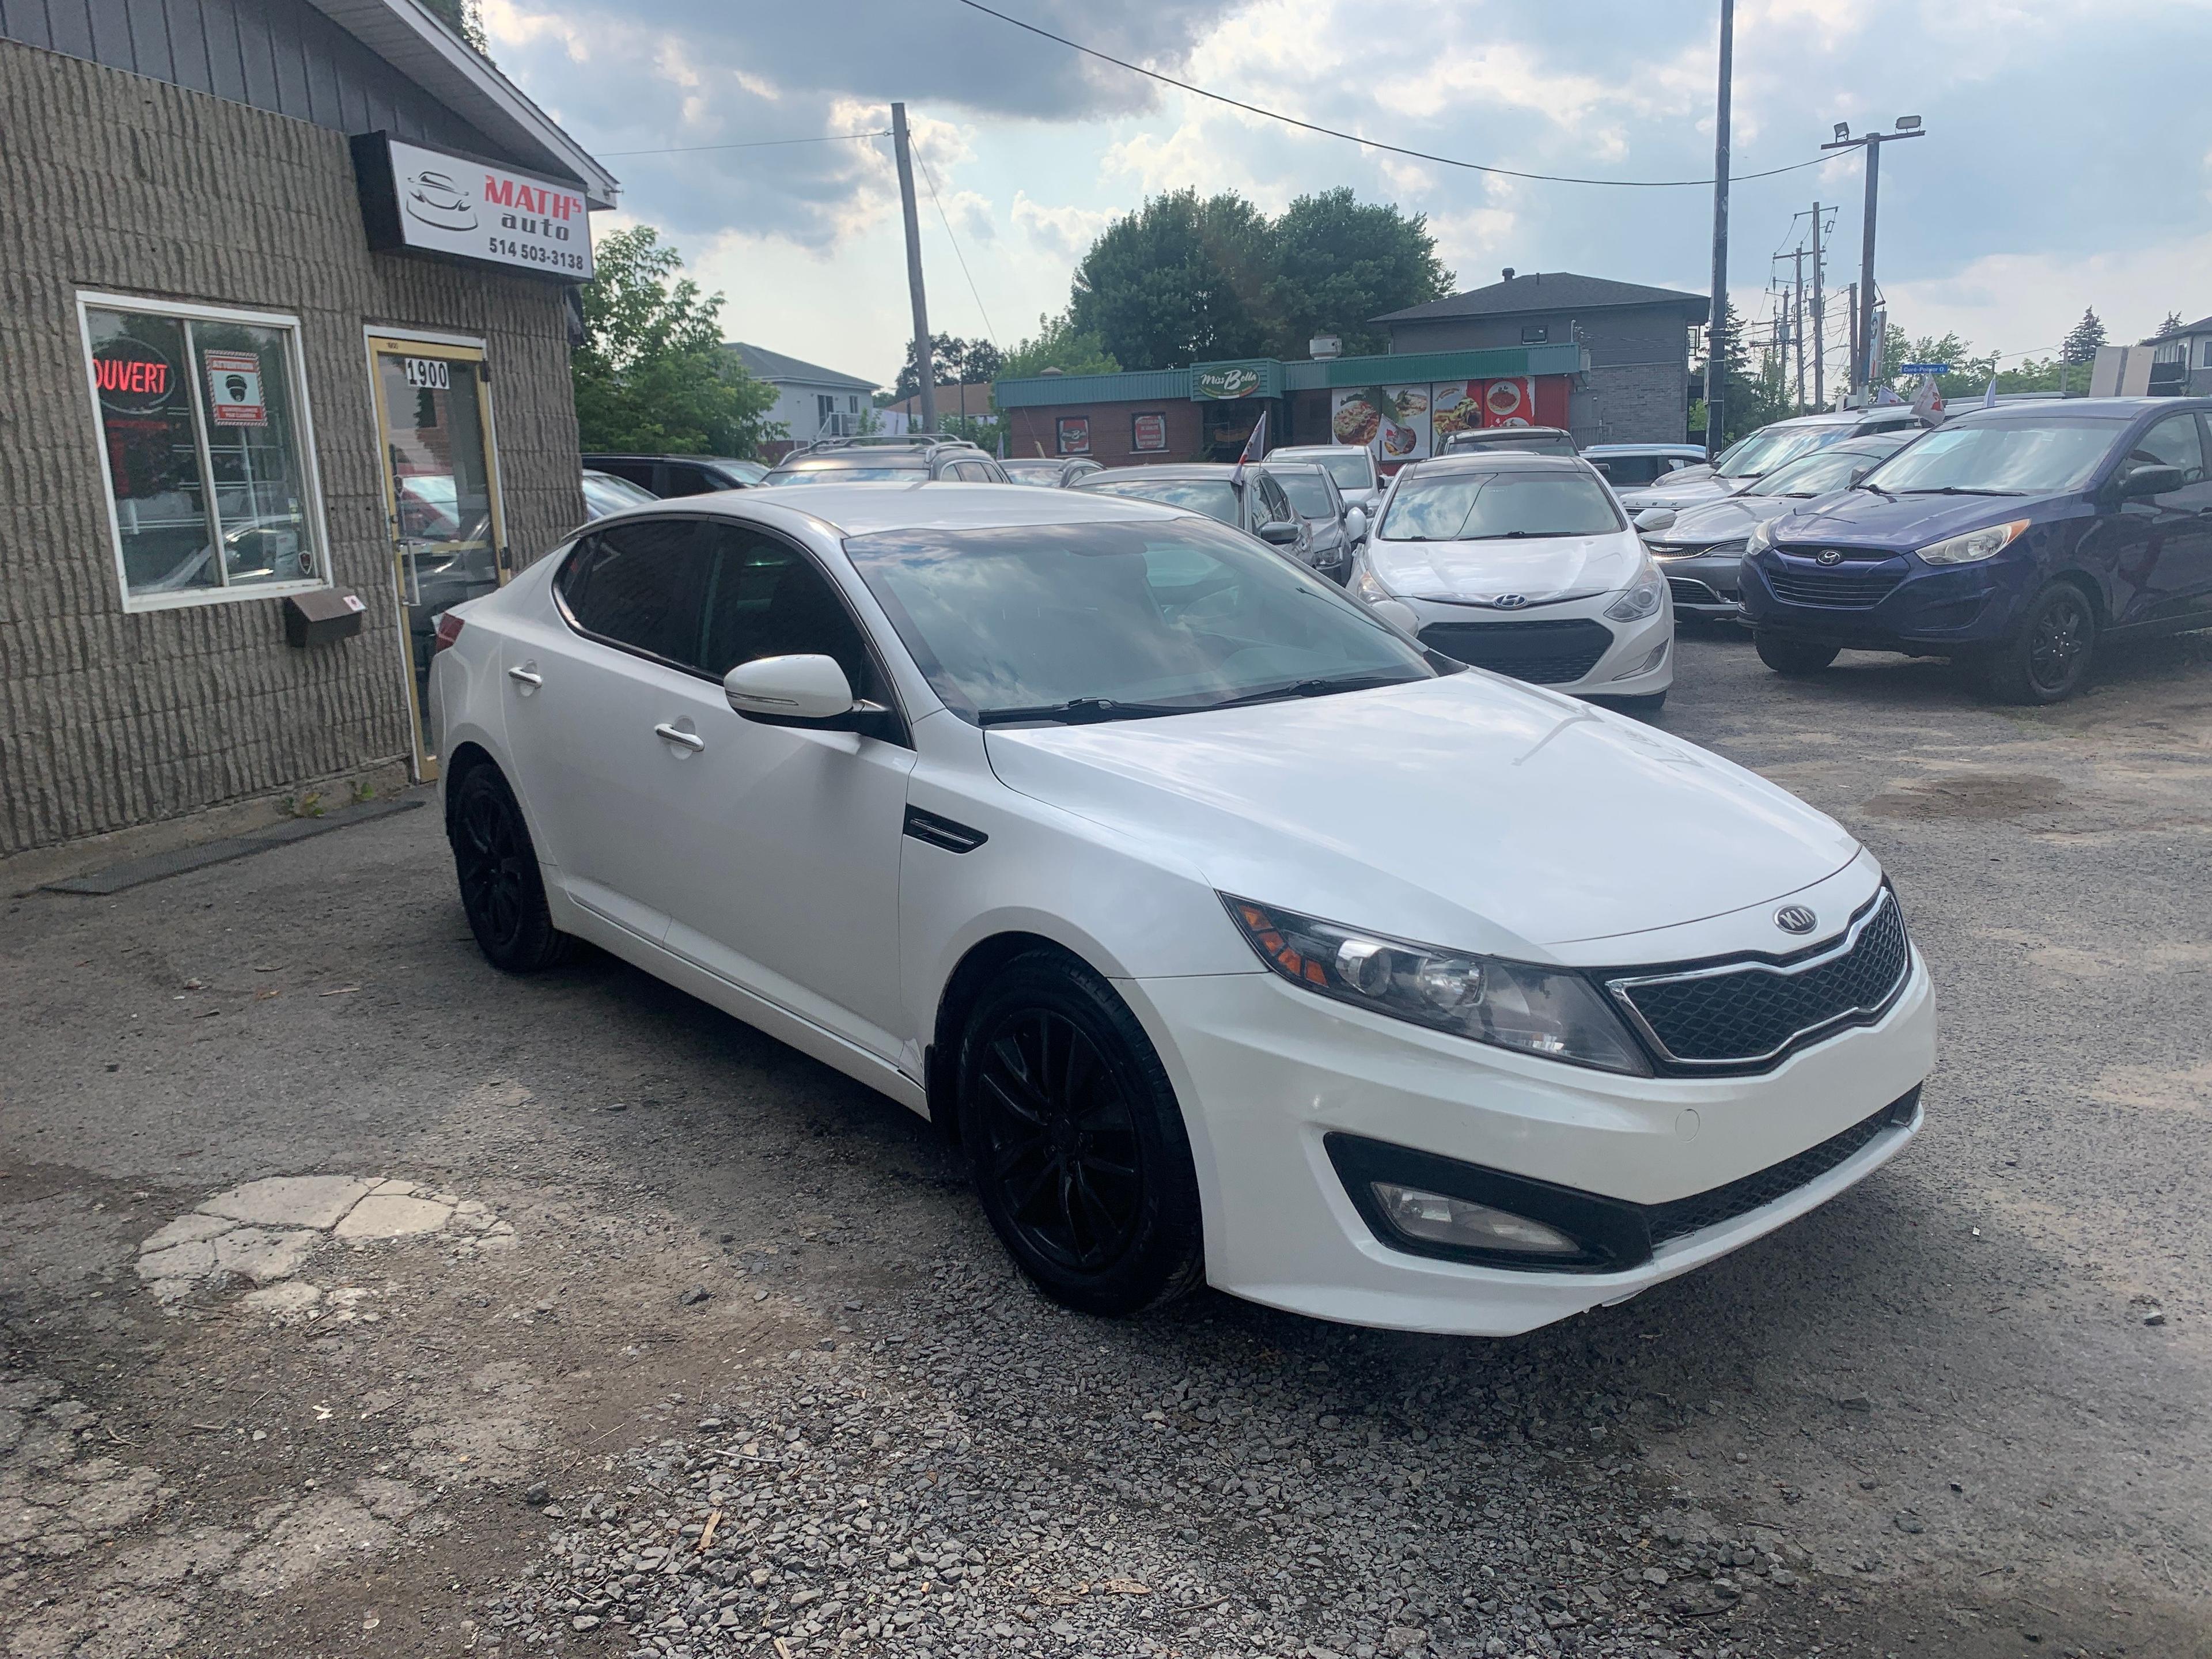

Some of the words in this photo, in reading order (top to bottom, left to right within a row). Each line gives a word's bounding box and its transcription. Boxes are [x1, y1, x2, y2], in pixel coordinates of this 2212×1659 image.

[502, 213, 569, 241] auto
[490, 237, 517, 257] 514
[521, 244, 583, 270] 503-3138
[408, 359, 446, 387] 1900
[1200, 374, 1225, 385] Miss
[1224, 370, 1256, 390] Bella
[1780, 908, 1815, 929] KIA
